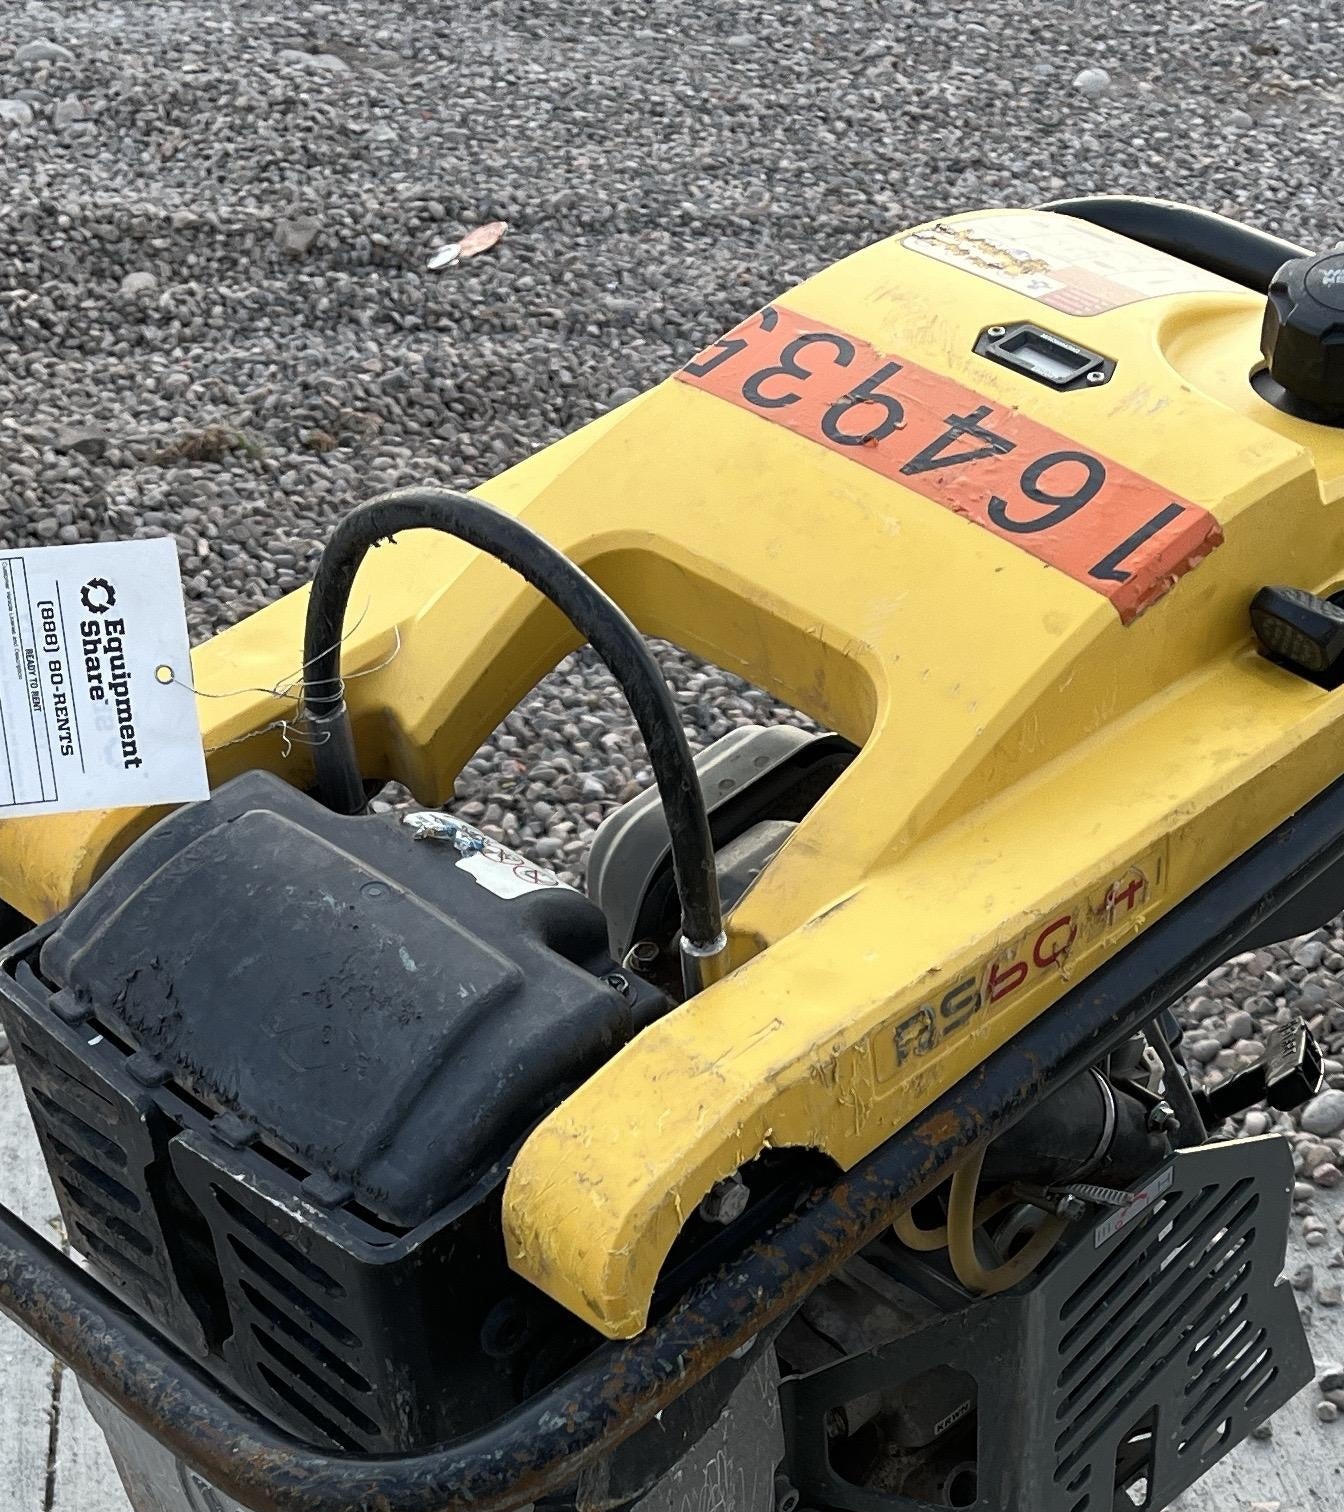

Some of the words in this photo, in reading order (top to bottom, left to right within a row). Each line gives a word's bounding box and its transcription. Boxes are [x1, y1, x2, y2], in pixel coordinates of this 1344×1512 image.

[38, 600, 60, 653] (888)
[25, 648, 37, 677] READY
[30, 679, 39, 689] TO
[32, 690, 41, 712] RENT
[102, 618, 143, 770] Equipment
[48, 659, 74, 757] 80-RENTS
